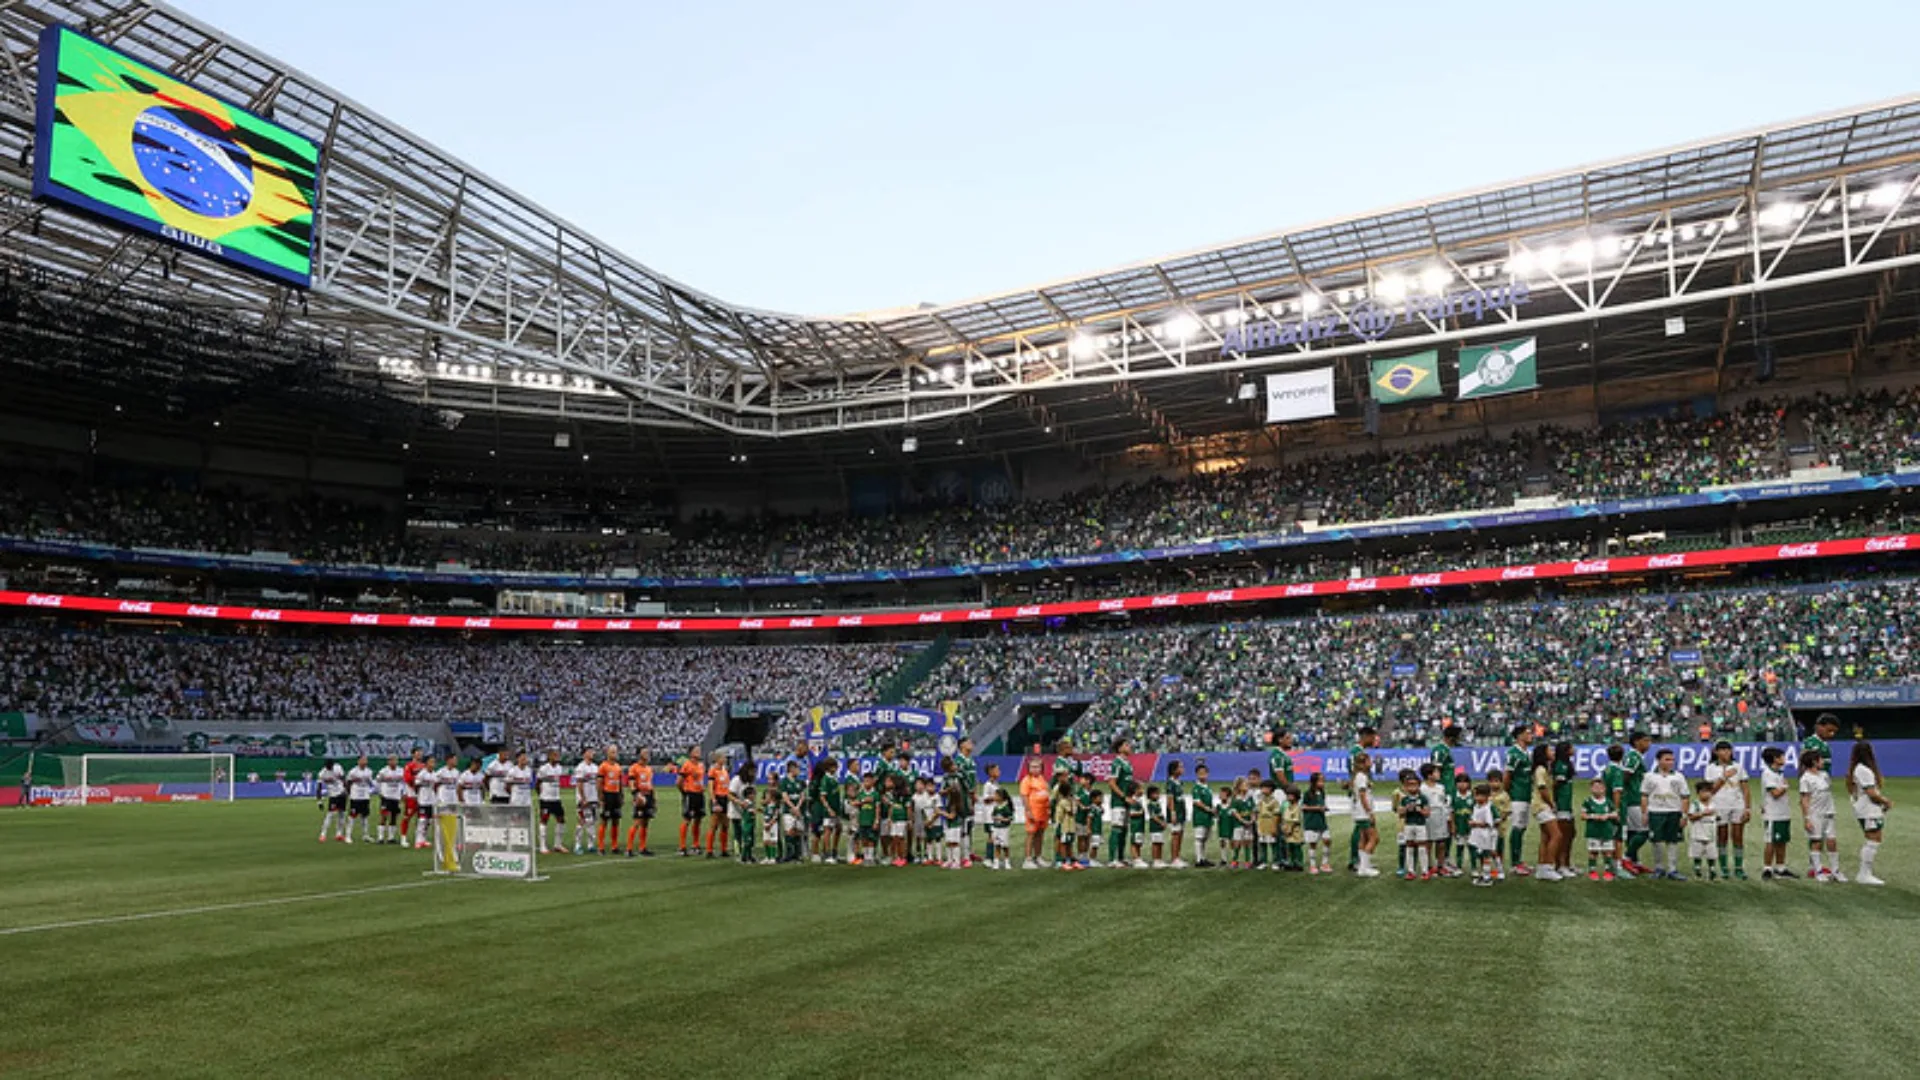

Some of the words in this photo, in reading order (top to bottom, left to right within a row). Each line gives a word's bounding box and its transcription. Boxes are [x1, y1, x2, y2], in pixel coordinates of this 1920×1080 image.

[1220, 314, 1341, 356] Allianz
[1404, 280, 1532, 324] Parque
[1857, 690, 1899, 702] Parque
[489, 856, 525, 871] Sicredi
